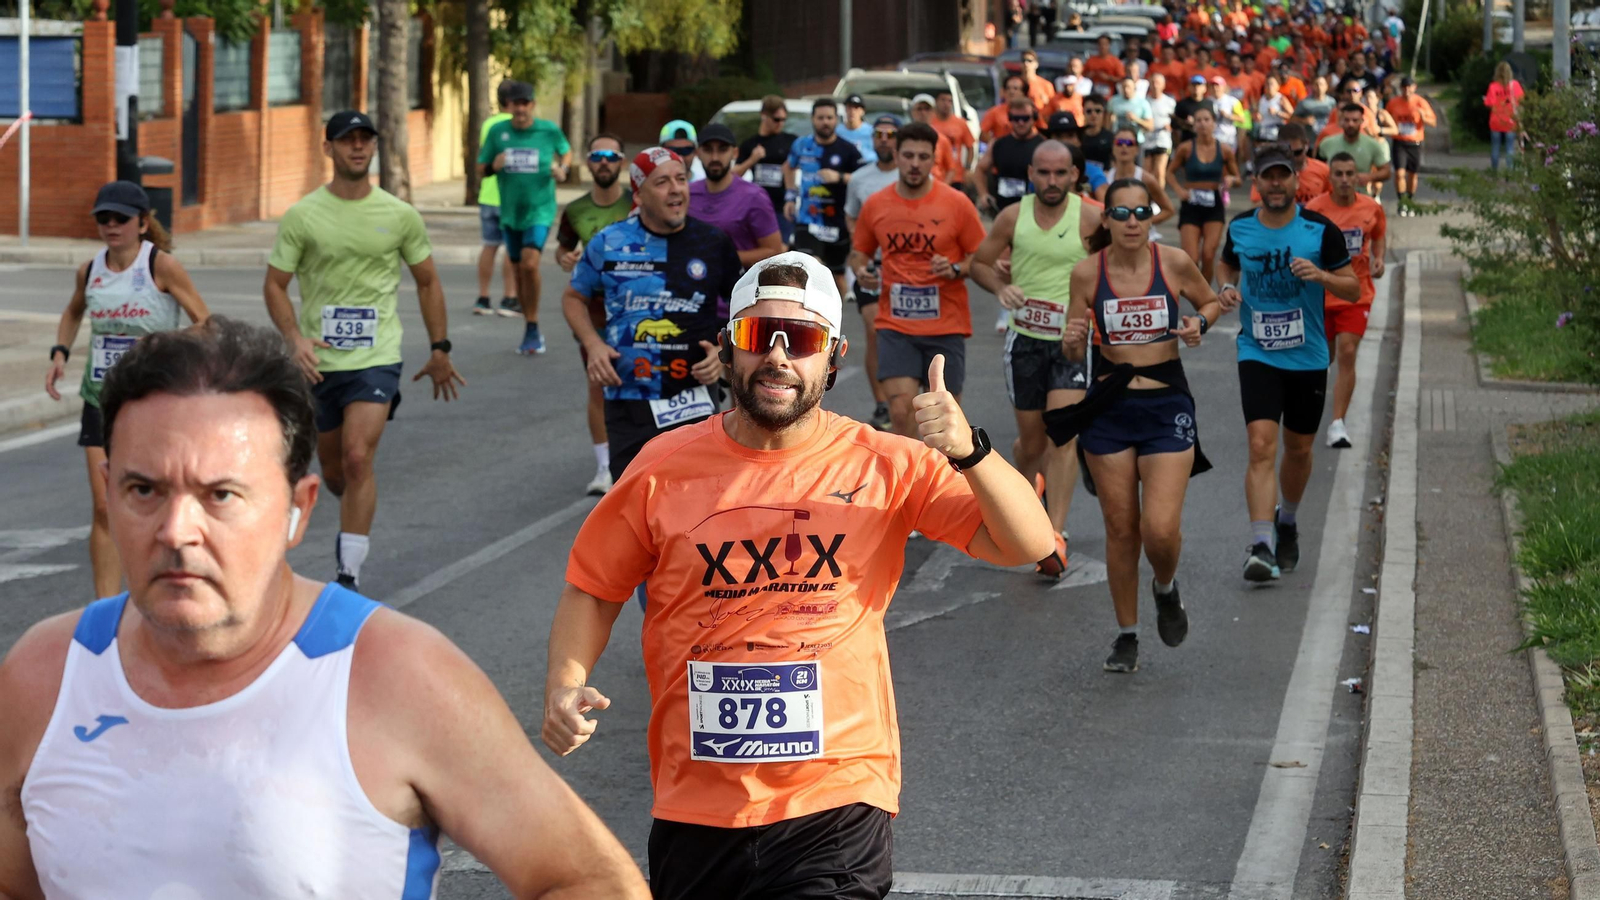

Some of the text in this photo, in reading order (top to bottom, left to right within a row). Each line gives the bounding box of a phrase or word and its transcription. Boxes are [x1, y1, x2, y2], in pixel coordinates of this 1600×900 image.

[899, 297, 930, 308] 1093
[1025, 309, 1051, 324] 385
[1121, 313, 1153, 328] 438
[335, 321, 363, 335] 638
[1264, 324, 1291, 337] 857
[696, 533, 846, 586] XXIX
[704, 581, 839, 599] MEDIA MARATÓN DE
[796, 671, 808, 679] 21
[721, 680, 755, 691] XXIX
[718, 697, 788, 730] 878
[735, 740, 814, 756] MIZUNO
